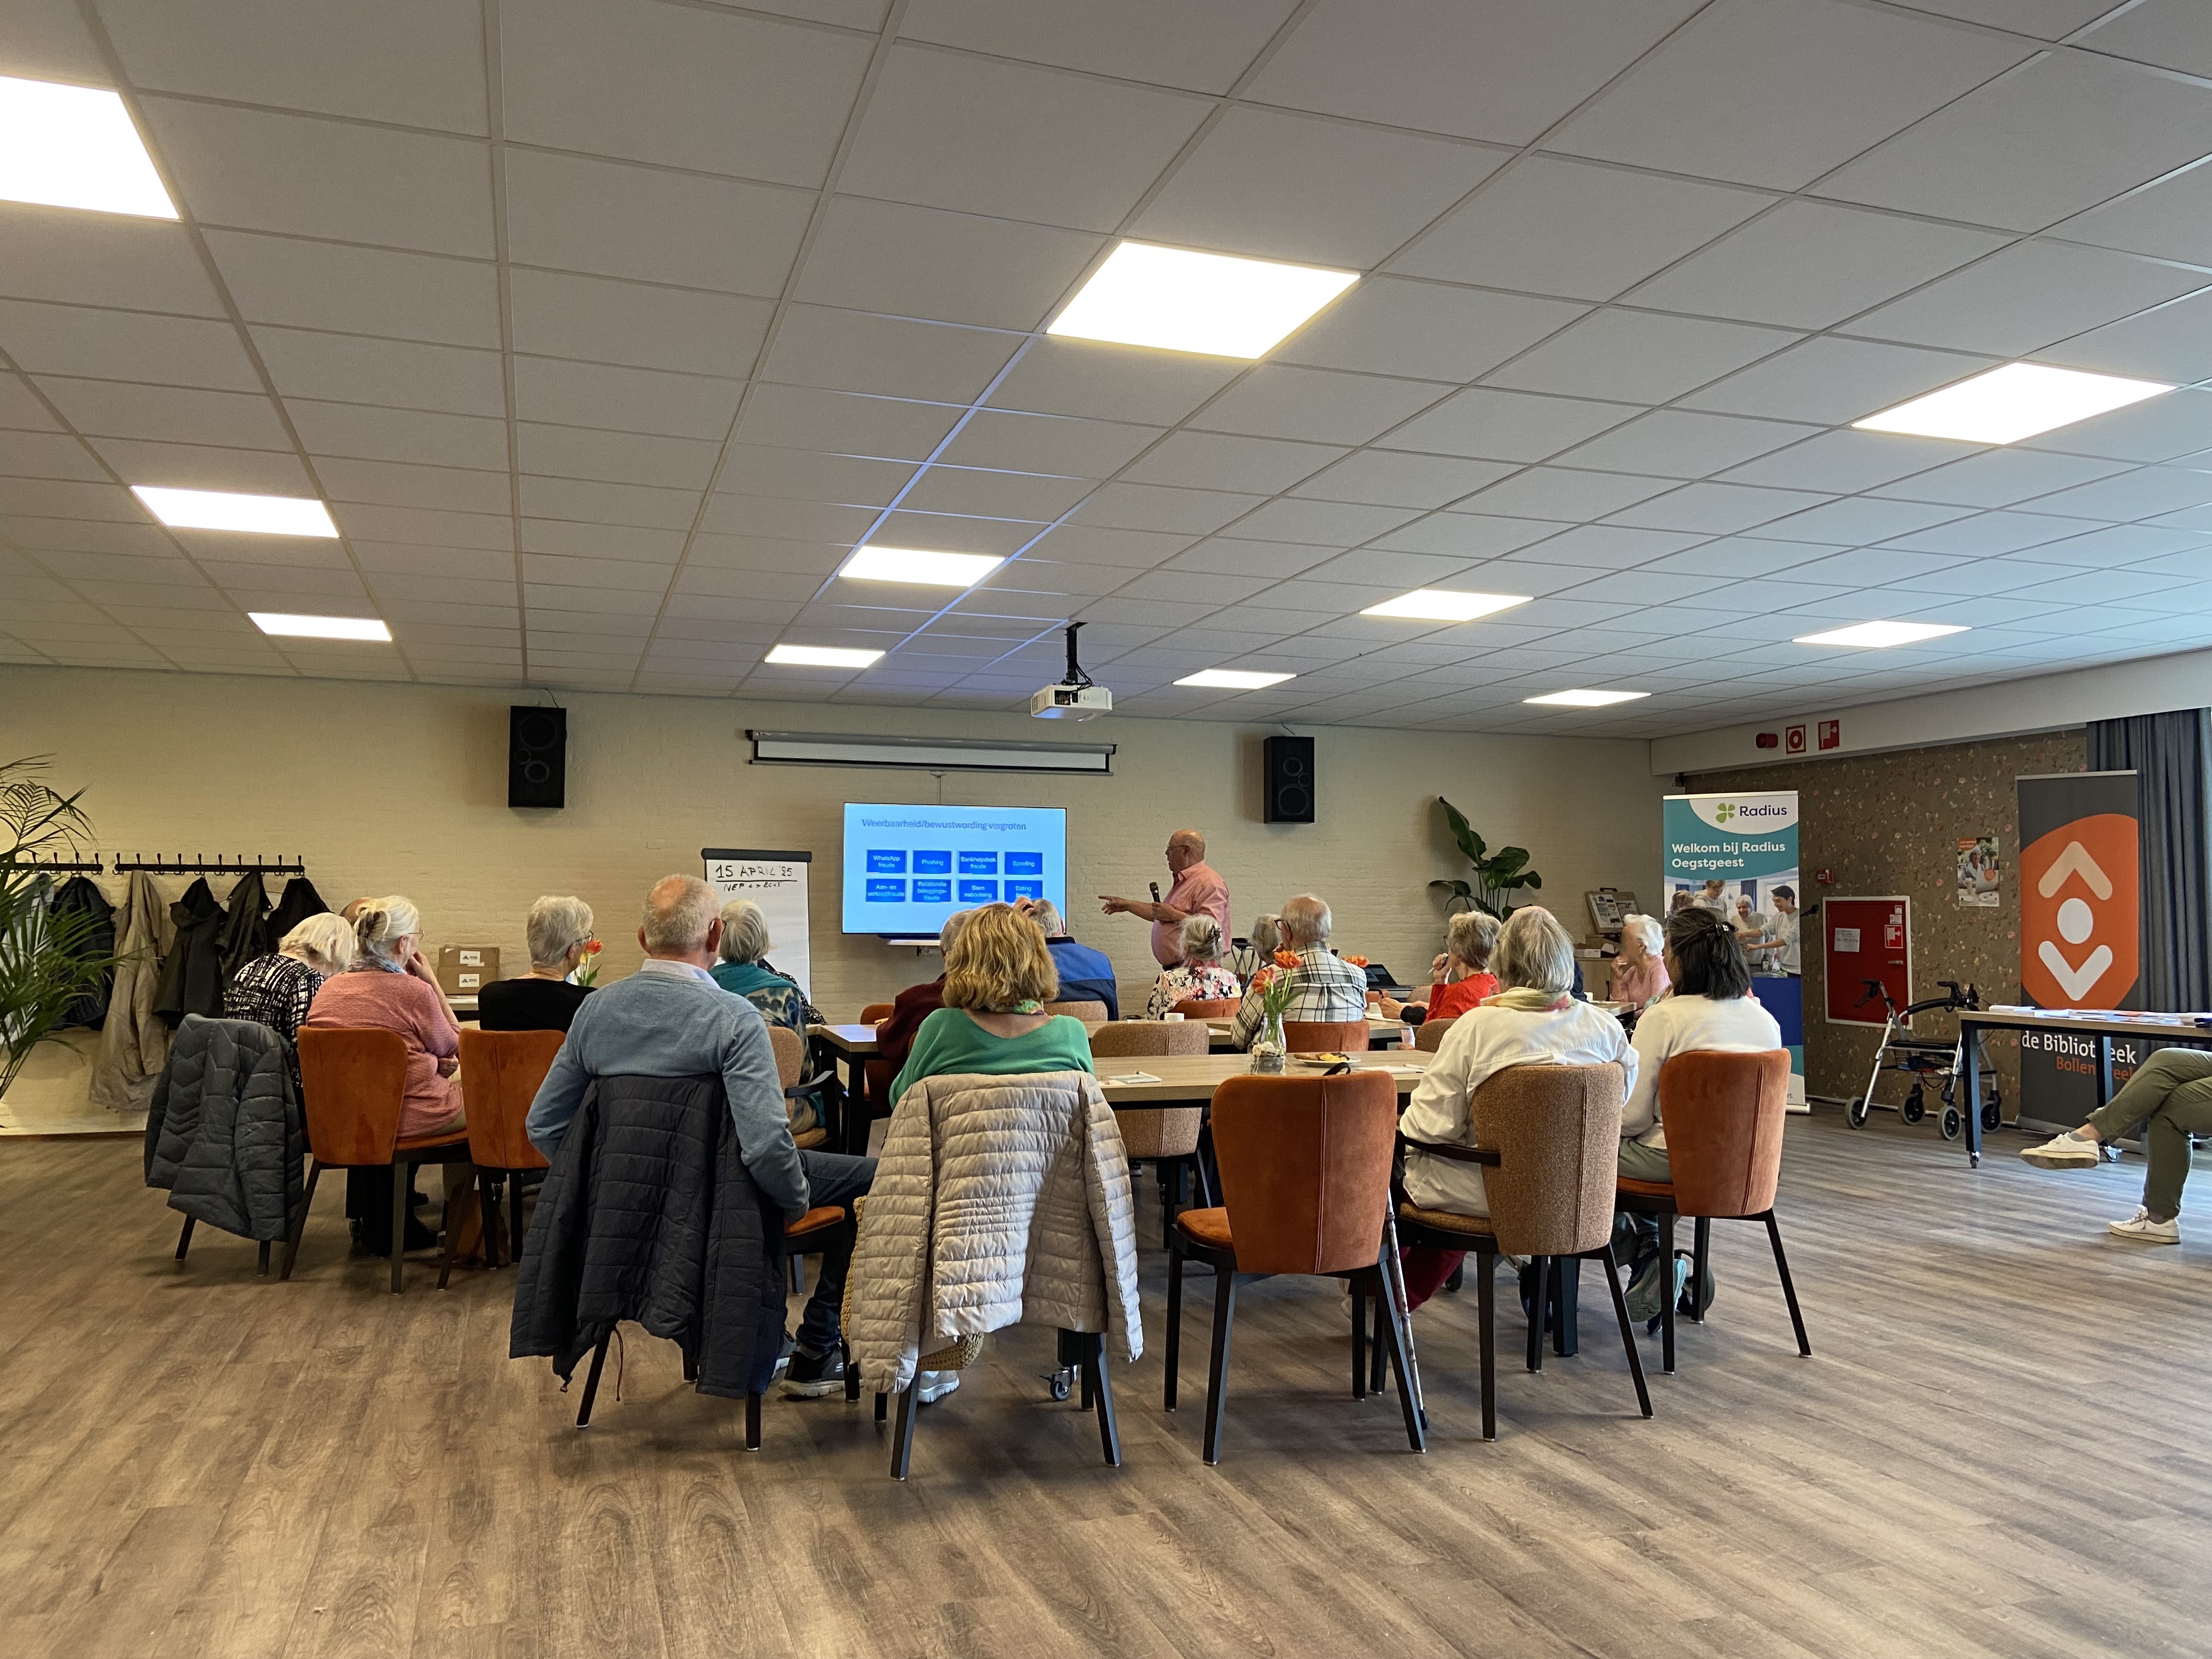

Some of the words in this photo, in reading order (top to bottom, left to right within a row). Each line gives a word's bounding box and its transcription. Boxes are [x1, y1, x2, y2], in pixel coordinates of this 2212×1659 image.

[1740, 805, 1787, 816] Radius
[862, 819, 988, 831] Weerbaarheid/bewustwording
[989, 823, 1026, 831] vergroten
[1672, 843, 1719, 854] Welkom
[1723, 843, 1739, 855] bij
[1742, 842, 1786, 852] Radius
[1672, 858, 1745, 870] Oegstgeest
[715, 864, 733, 878] 15
[741, 865, 776, 877] APRIL
[724, 883, 744, 892] NEP
[2022, 1030, 2039, 1049] de
[2044, 1034, 2136, 1064] Biblioteek
